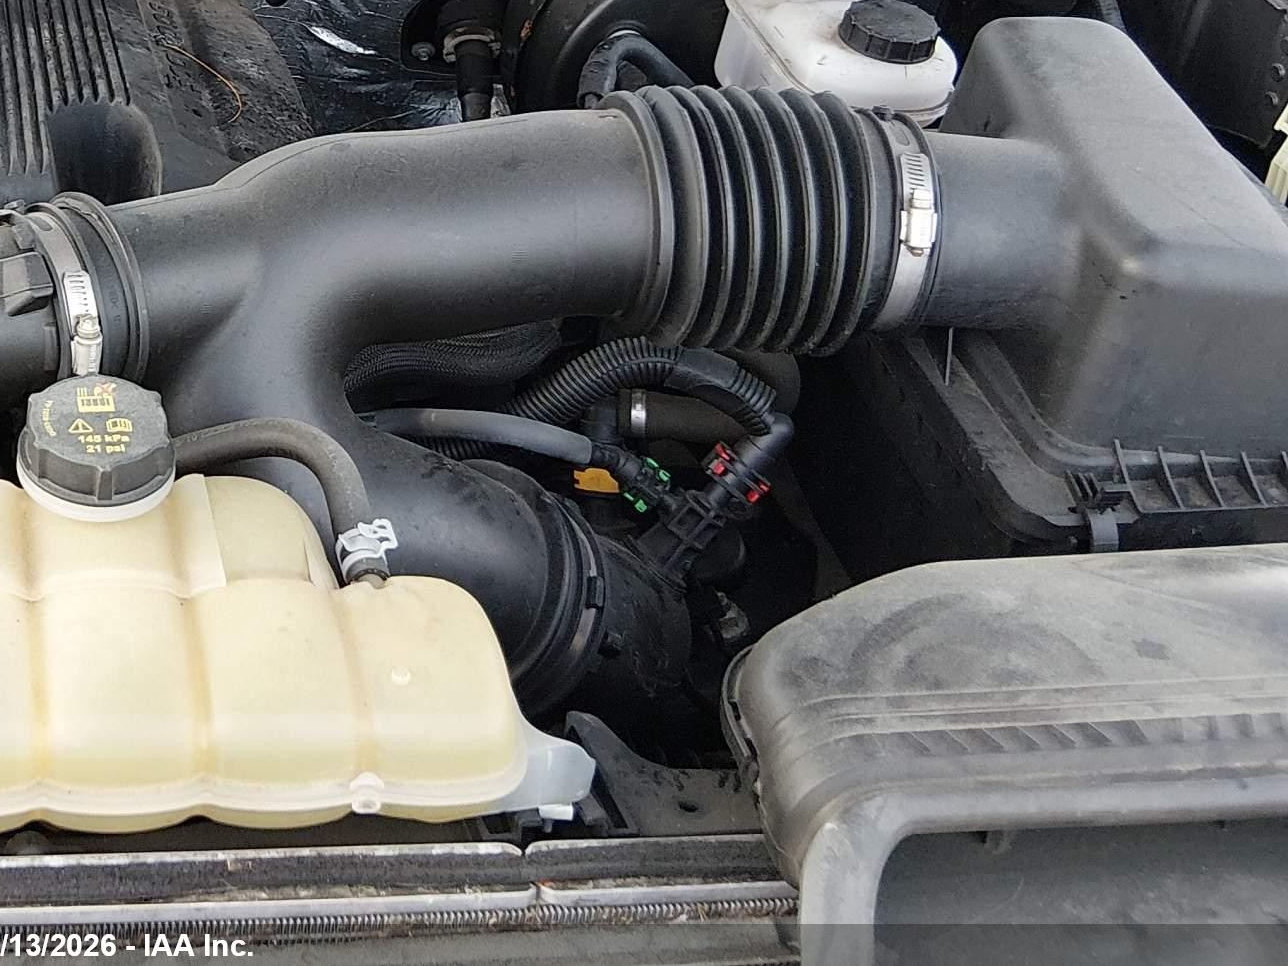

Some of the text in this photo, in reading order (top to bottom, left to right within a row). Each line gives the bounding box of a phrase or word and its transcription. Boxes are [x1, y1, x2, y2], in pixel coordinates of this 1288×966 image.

[103, 434, 130, 443] kPa
[86, 443, 126, 454] 21 psi
